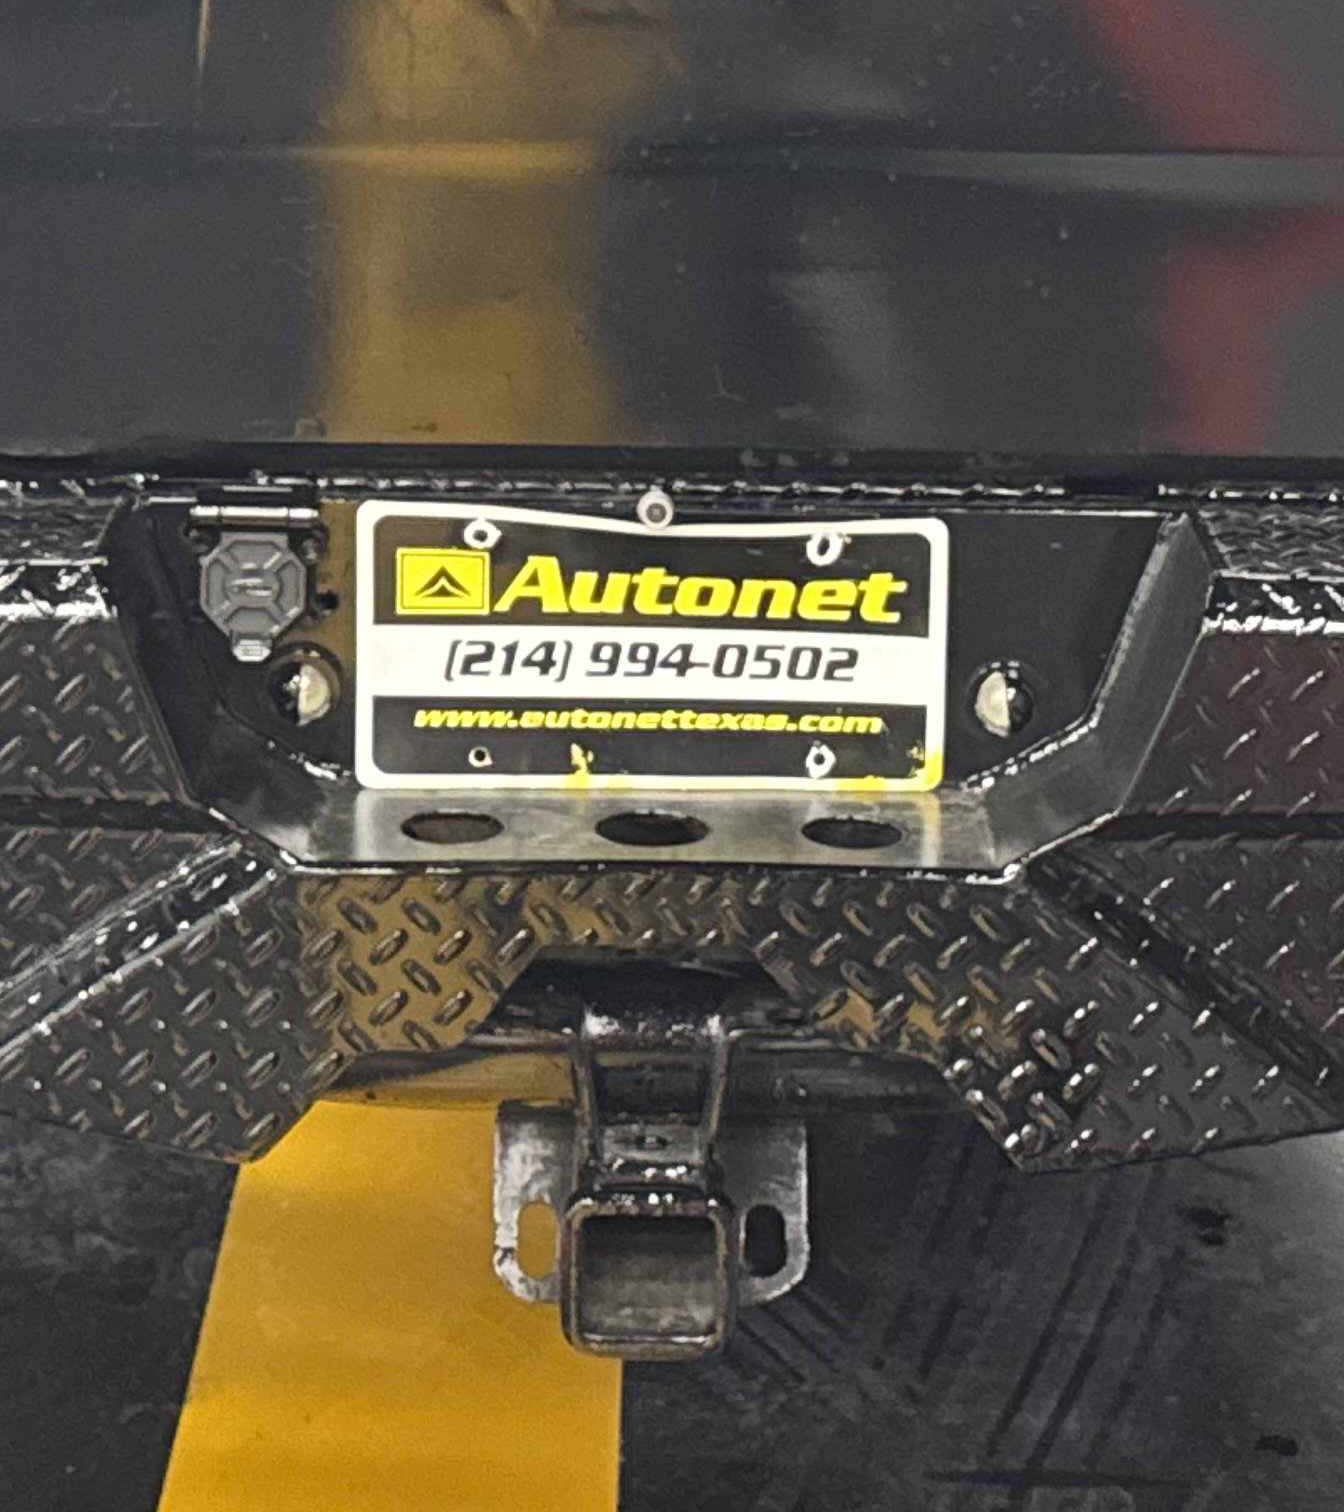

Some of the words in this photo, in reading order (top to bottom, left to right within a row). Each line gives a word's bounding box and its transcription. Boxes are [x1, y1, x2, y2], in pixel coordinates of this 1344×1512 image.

[493, 554, 909, 624] Autonet
[443, 639, 574, 683] (214)
[585, 641, 860, 683] 994-0502
[413, 708, 884, 735] www.autonettexas.com
